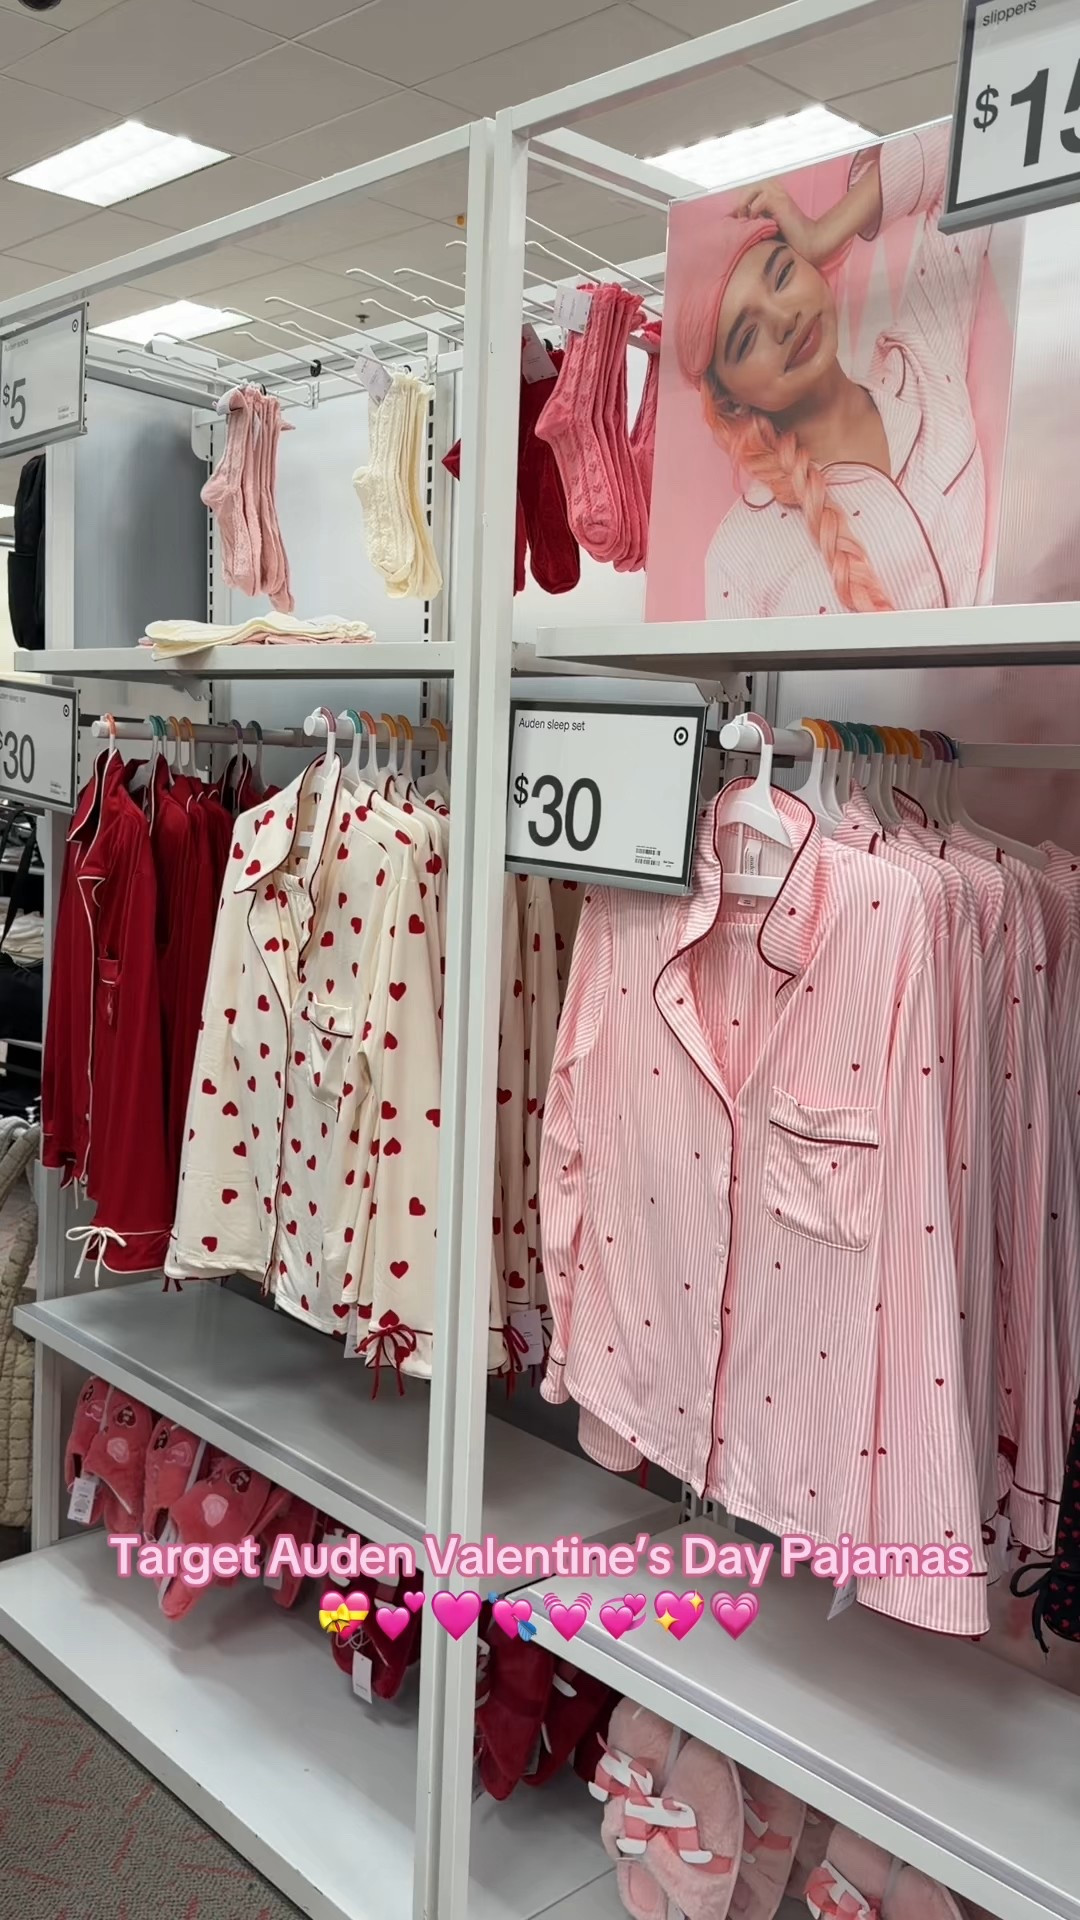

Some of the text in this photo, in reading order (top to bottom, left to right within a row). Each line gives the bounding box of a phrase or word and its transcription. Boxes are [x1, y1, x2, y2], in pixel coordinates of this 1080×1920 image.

[982, 0, 1037, 27] slippers
[2, 377, 26, 430] $5
[518, 717, 586, 733] Auden sleep set
[513, 773, 602, 852] $30
